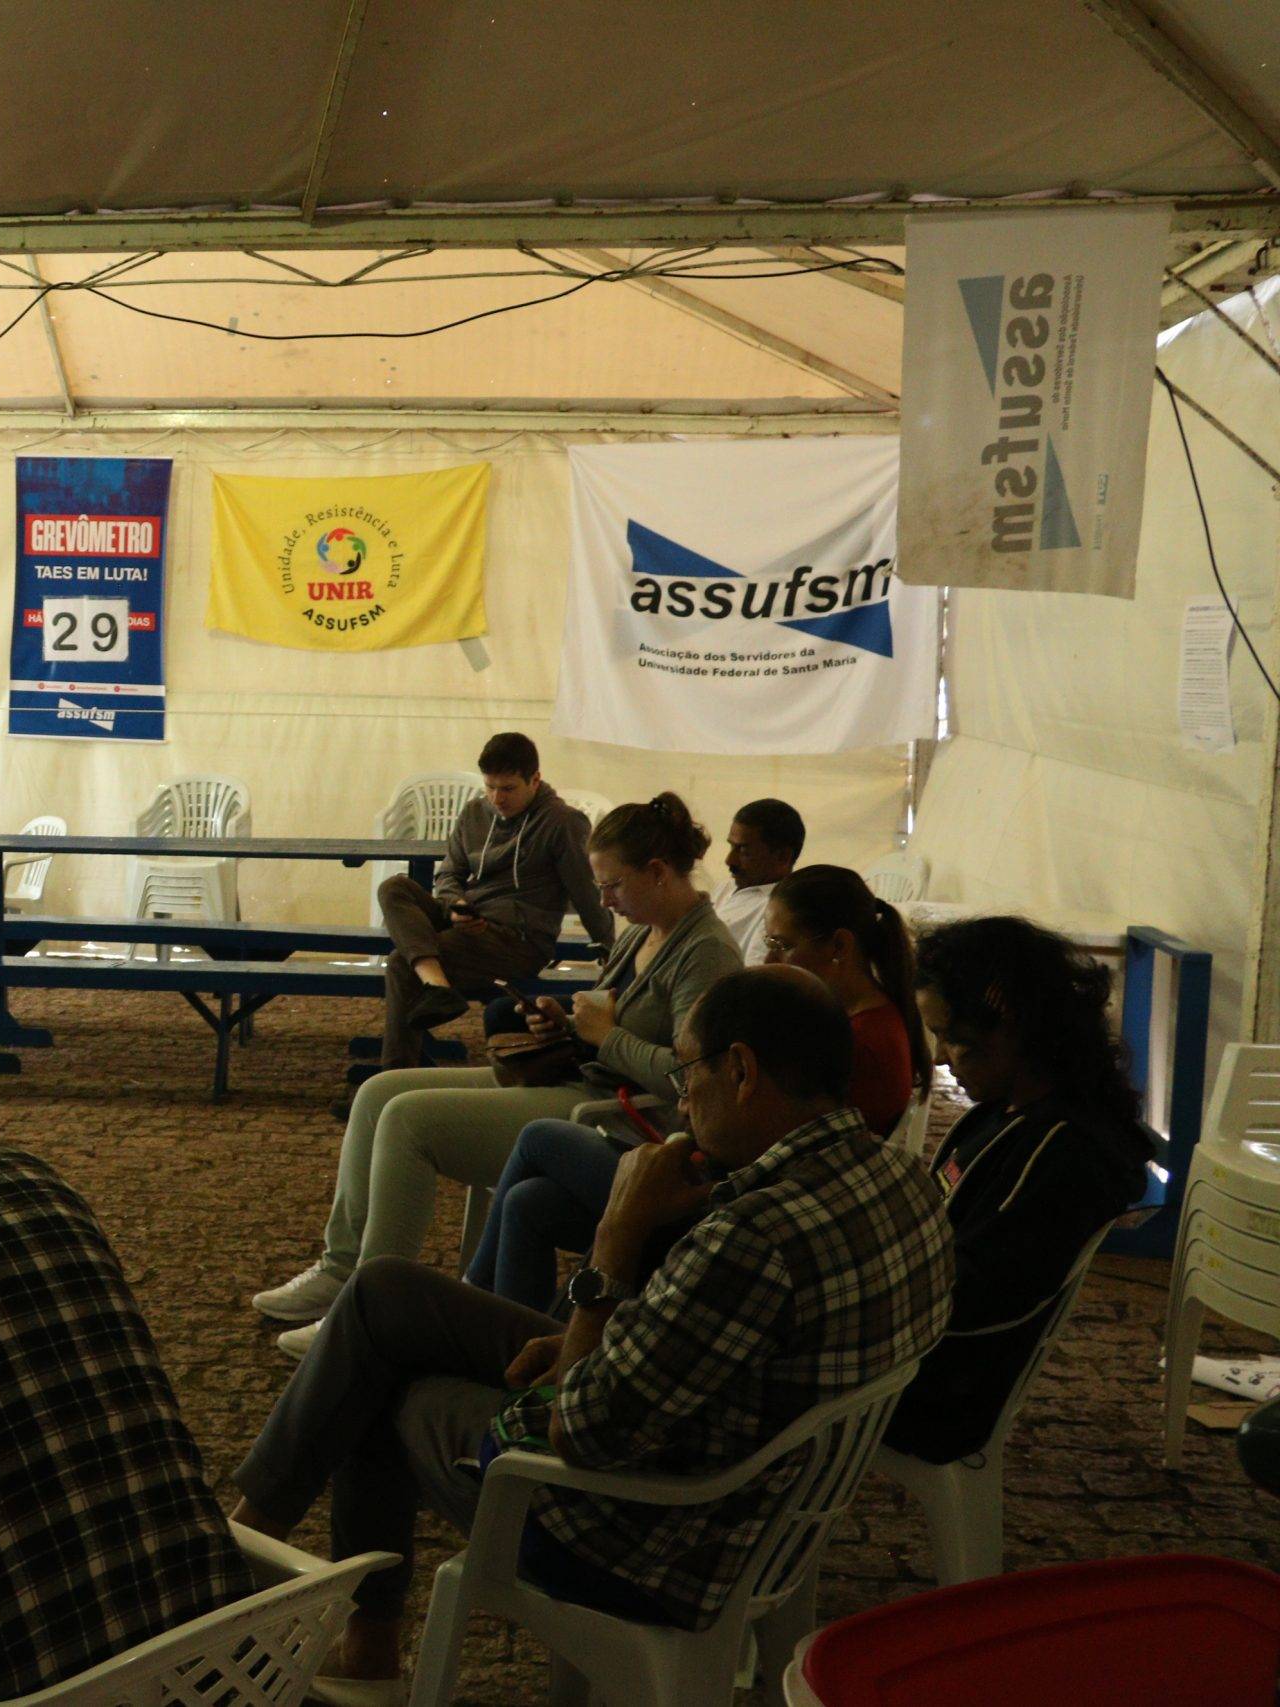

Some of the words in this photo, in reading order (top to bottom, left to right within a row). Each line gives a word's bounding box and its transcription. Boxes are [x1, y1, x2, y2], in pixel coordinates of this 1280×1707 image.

[305, 504, 392, 538] Resistência
[31, 514, 153, 554] GREVÔMETRO
[388, 540, 398, 549] e
[34, 565, 73, 580] TAES
[77, 566, 100, 580] EM
[104, 567, 148, 581] LUTA!
[278, 529, 306, 594] Unidade,
[387, 553, 404, 588] Luta
[307, 581, 374, 601] UNIR
[630, 558, 890, 620] assufsm
[302, 604, 386, 631] ASSUFSM
[639, 643, 700, 660] Associação
[704, 652, 726, 662] dos
[730, 650, 796, 662] Servidores
[800, 647, 816, 657] da
[638, 658, 708, 676] Universidade
[712, 667, 760, 677] Federal
[763, 666, 778, 676] de
[782, 662, 819, 675] Santa
[822, 655, 857, 669] Maria
[57, 707, 116, 720] assufsm
